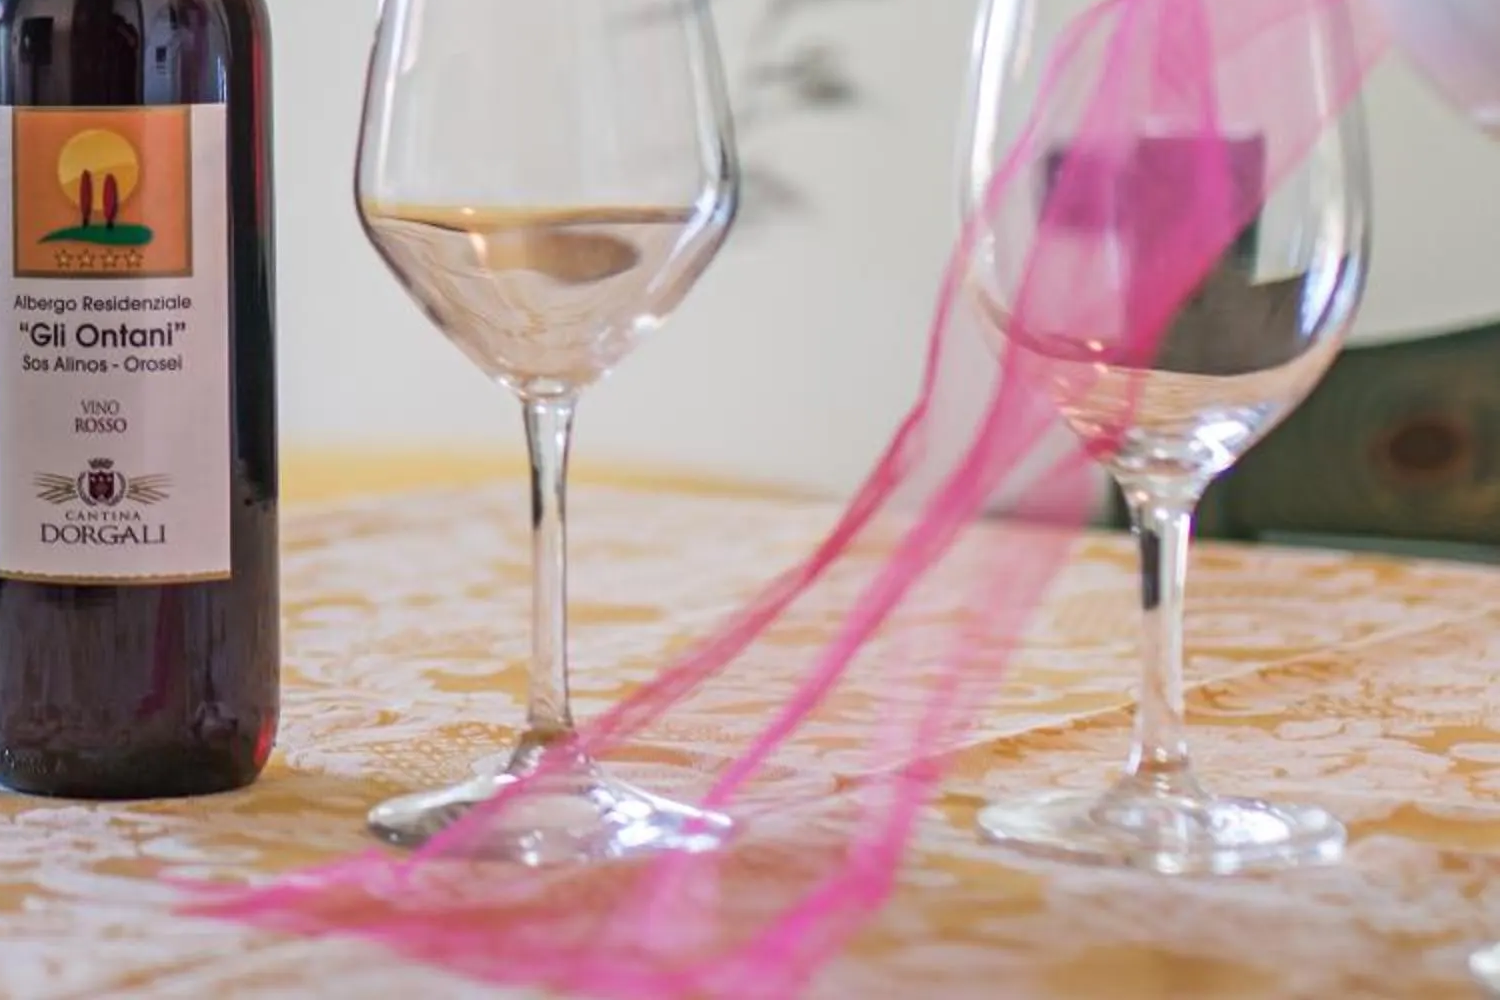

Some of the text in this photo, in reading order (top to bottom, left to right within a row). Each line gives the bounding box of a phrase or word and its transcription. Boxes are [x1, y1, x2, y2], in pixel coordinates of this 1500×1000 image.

[13, 294, 192, 314] Albergo Residenziale
[22, 354, 49, 371] Sos
[53, 355, 108, 373] Alinos
[123, 354, 183, 372] Orosei
[81, 400, 120, 415] VINO
[75, 417, 127, 433] ROSSO
[65, 511, 141, 522] CANTINA
[41, 523, 166, 545] DORGALI
